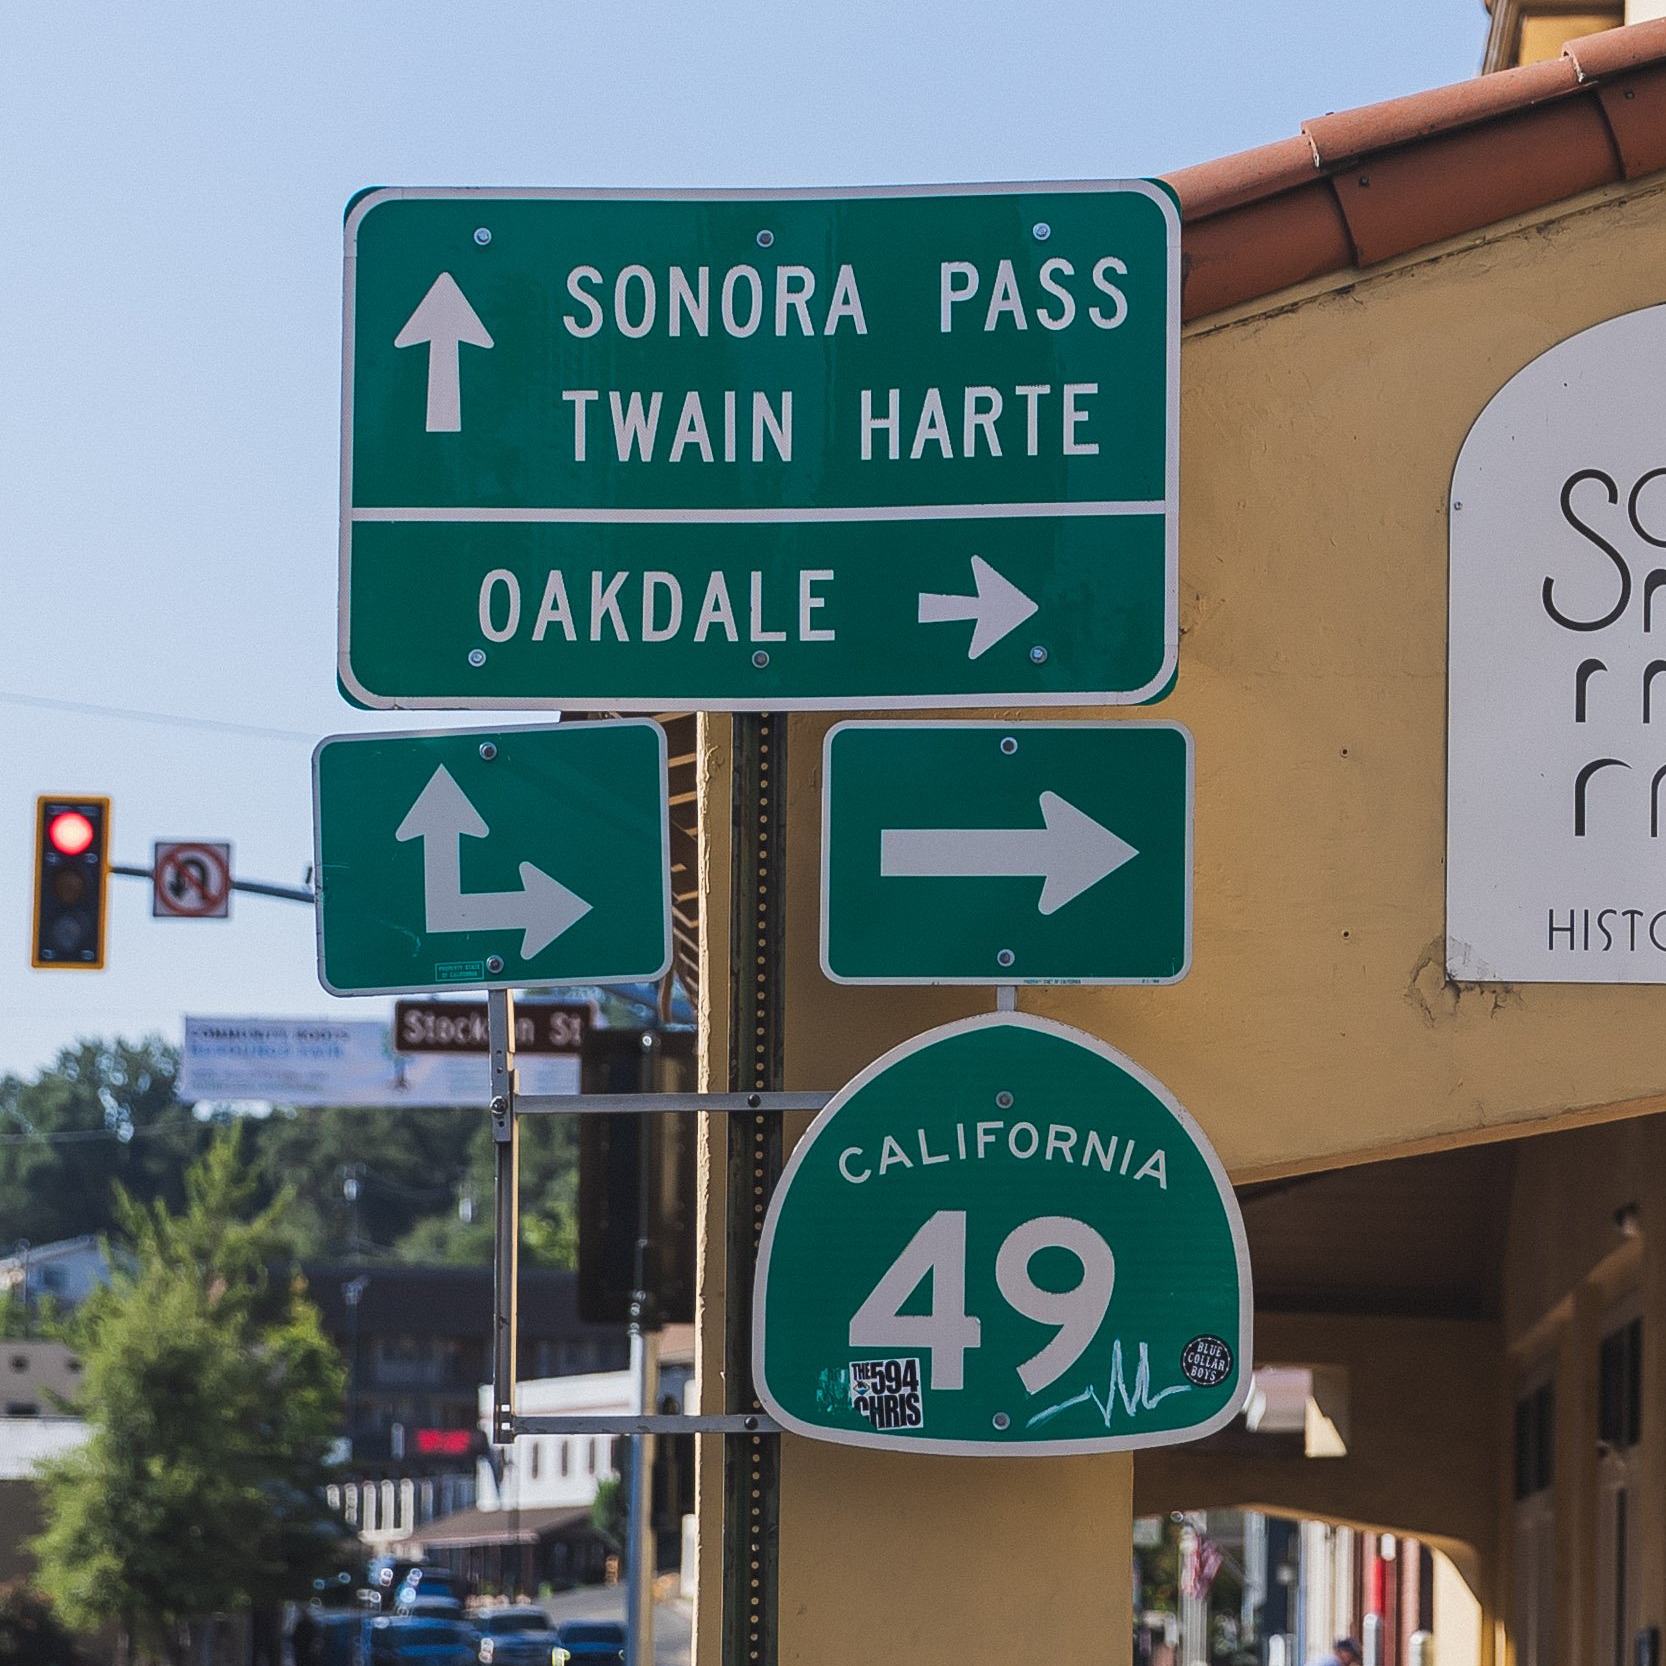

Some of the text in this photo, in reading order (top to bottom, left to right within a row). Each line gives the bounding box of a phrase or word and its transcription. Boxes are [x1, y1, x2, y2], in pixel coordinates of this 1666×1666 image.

[561, 256, 1129, 338] SONORA PASS
[561, 382, 1100, 462] TWAIN HARTE
[478, 569, 836, 643] OAKDALE
[403, 1008, 535, 1046] Stockn
[838, 1120, 1169, 1190] CALIFORNIA
[848, 1209, 1116, 1395] 49
[1187, 1352, 1225, 1371] COLLAR
[1197, 1342, 1223, 1357] BLUE
[851, 1359, 919, 1395] THE 594
[1190, 1366, 1217, 1381] BOYS
[853, 1392, 922, 1429] CHRIS
